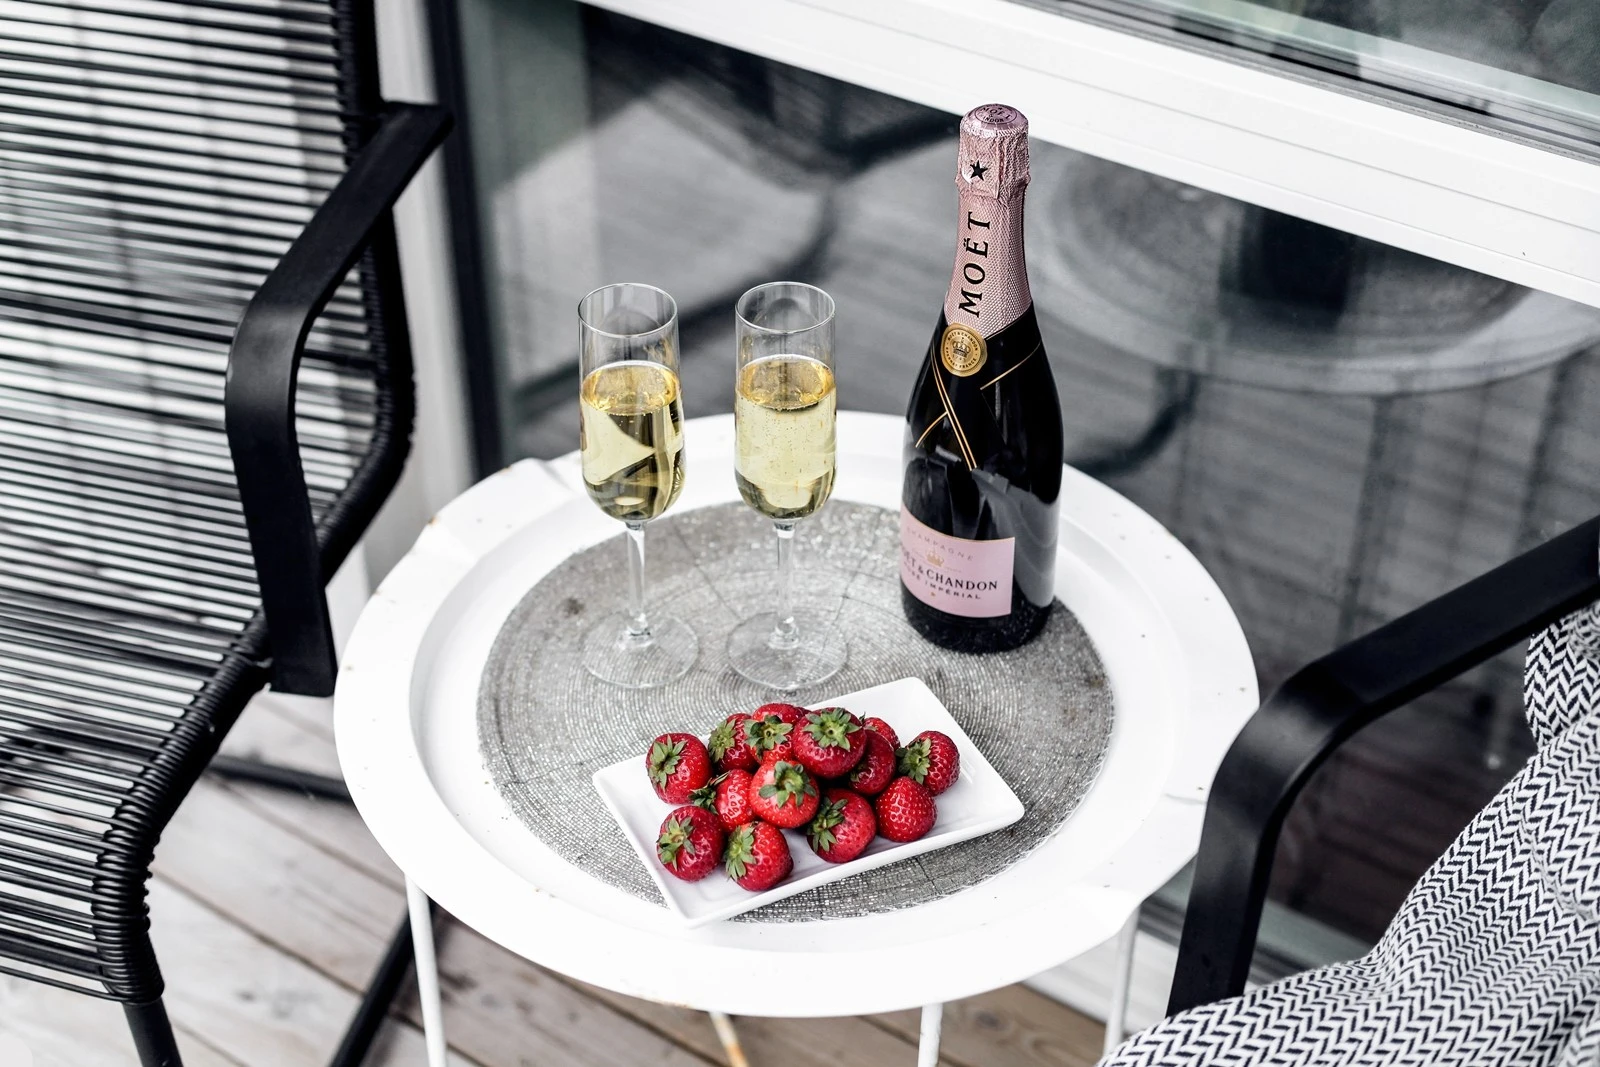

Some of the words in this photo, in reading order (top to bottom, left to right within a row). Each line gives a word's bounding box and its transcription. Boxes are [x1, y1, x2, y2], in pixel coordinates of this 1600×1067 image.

[958, 211, 990, 318] MOËT
[906, 526, 974, 562] CHAMPAGNE
[926, 568, 998, 591] CHANDON
